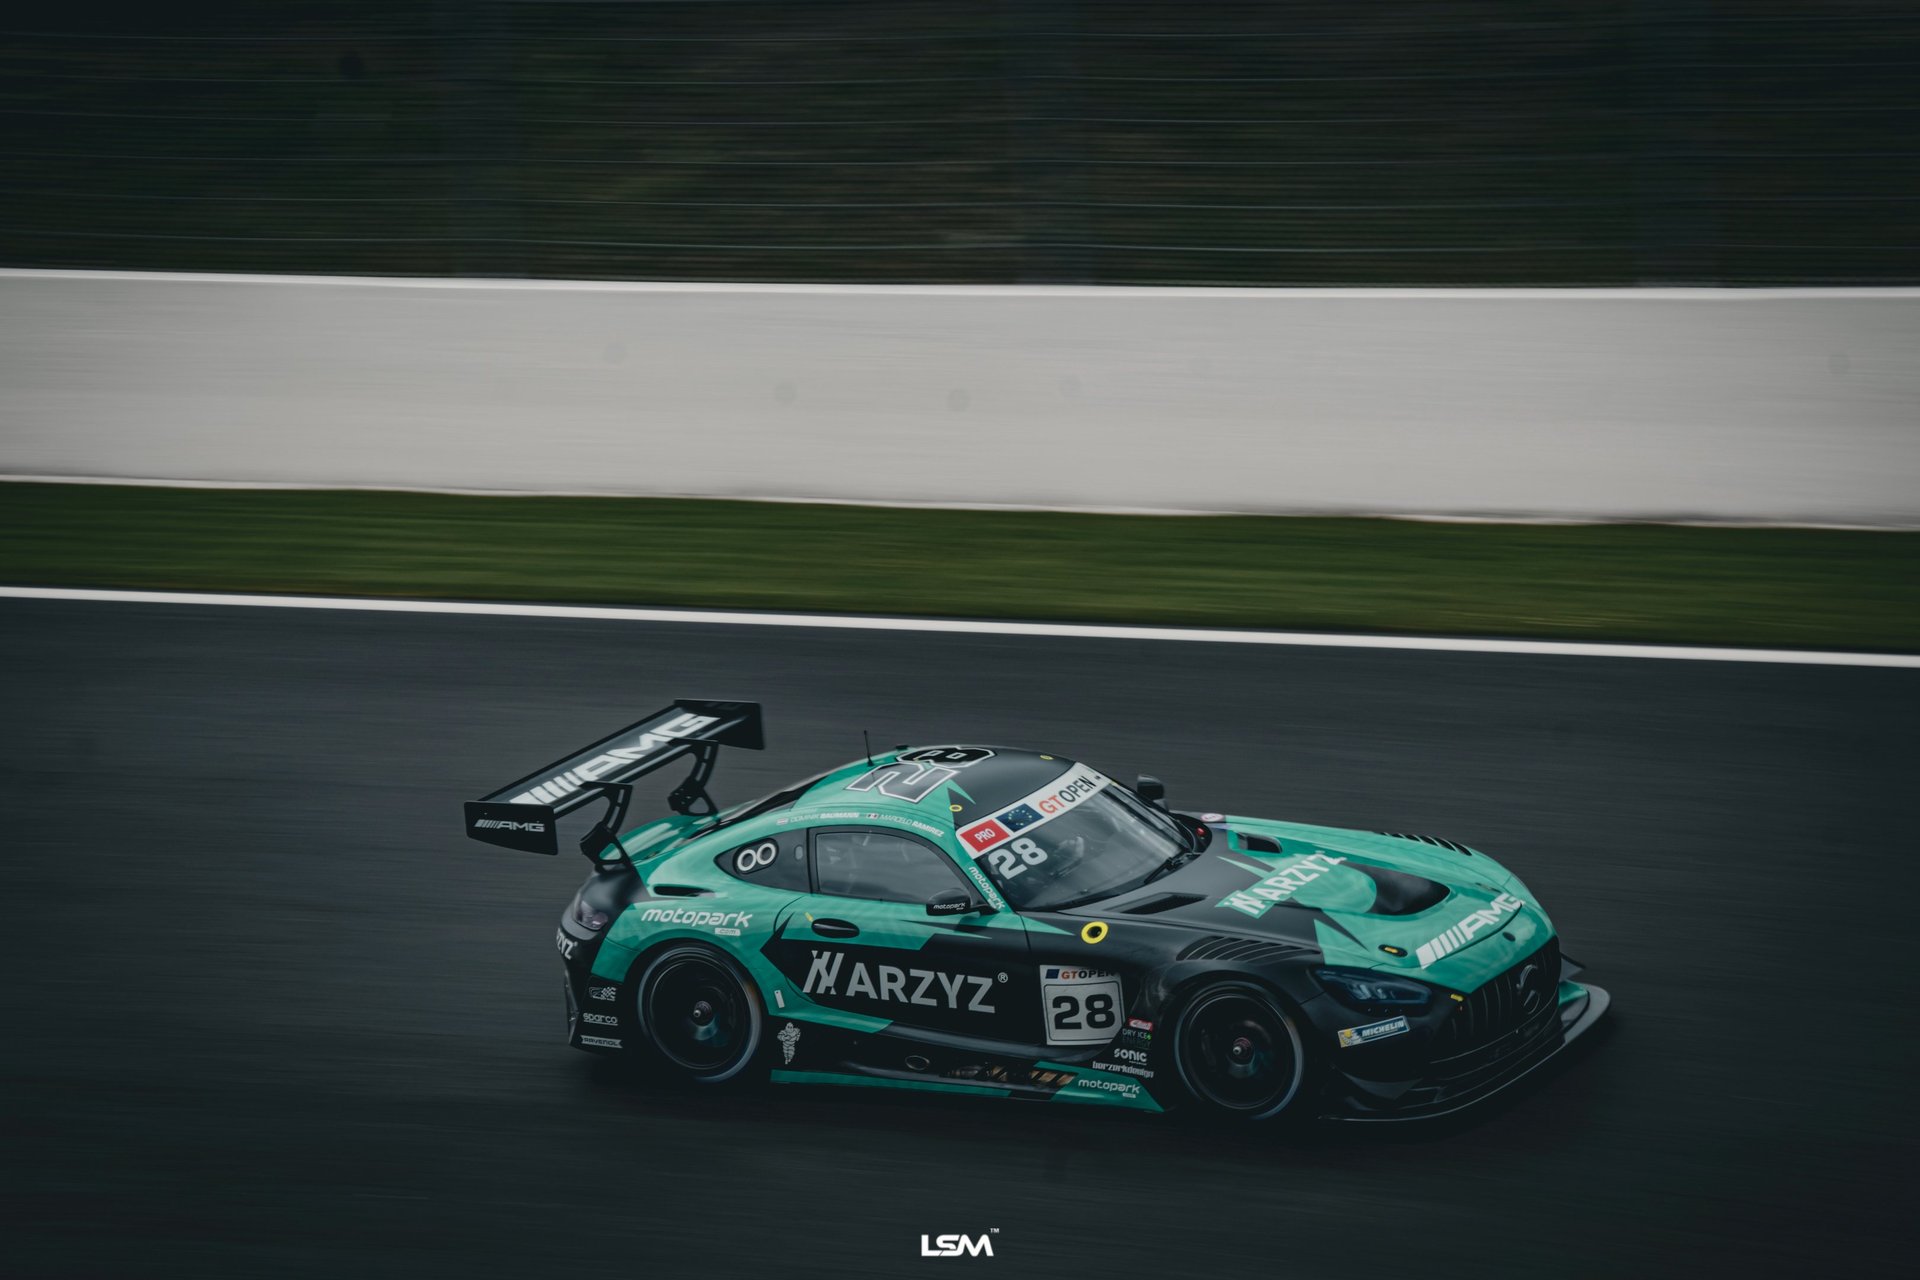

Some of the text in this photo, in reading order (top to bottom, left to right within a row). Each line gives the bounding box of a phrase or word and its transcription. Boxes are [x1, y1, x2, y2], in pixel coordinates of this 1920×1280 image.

[572, 713, 721, 782] AMG
[496, 820, 545, 833] AMG
[912, 821, 945, 837] RAMIREZ
[974, 828, 996, 843] PRO
[988, 838, 1048, 880] 28
[968, 866, 1006, 910] motopark
[933, 902, 966, 910] motopark
[641, 908, 752, 928] motopark
[583, 1012, 618, 1025] sparco
[1053, 994, 1115, 1029] 28
[1361, 1020, 1404, 1037] MICHELIN
[1078, 1079, 1140, 1095] motopark
